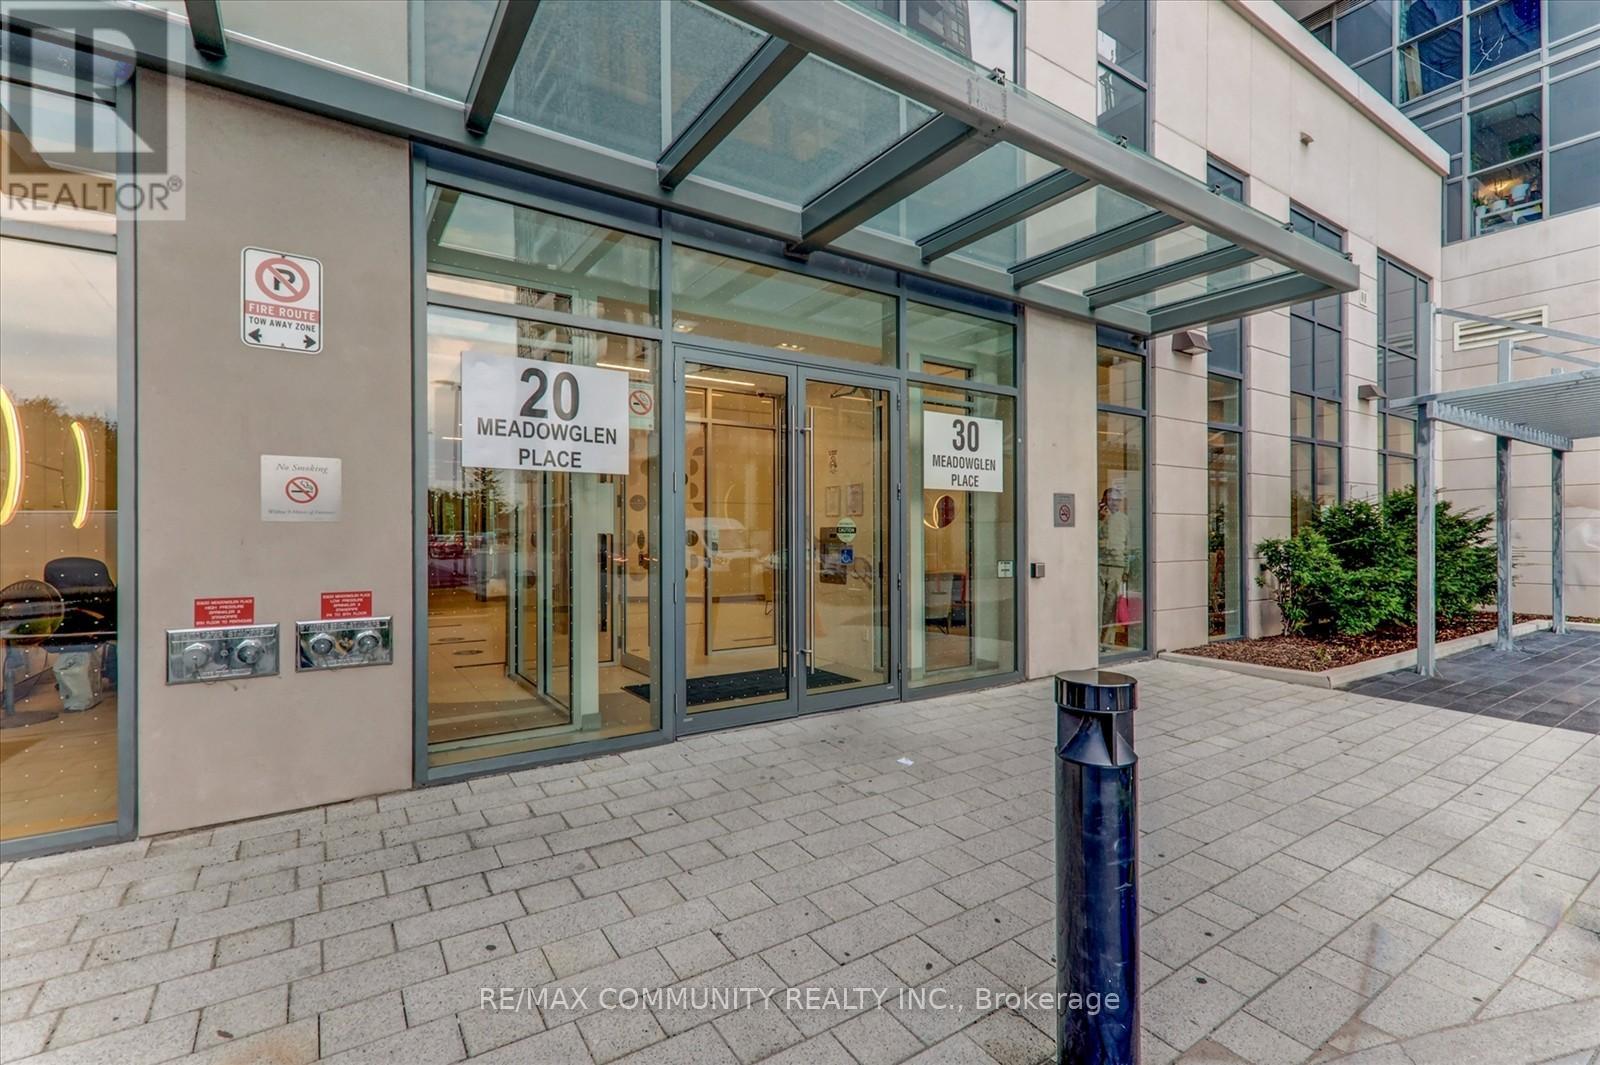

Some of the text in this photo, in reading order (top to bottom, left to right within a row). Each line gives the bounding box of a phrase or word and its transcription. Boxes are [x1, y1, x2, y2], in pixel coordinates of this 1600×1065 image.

[248, 303, 316, 320] FIRE ROUTE
[249, 316, 316, 332] TOW AWAY ZONE
[520, 367, 580, 421] 20
[478, 417, 617, 445] MEADOWGLEN
[952, 419, 980, 452] 30
[519, 448, 582, 468] PLACE
[932, 454, 996, 471] MEADOWGLEN
[292, 464, 328, 474] Smoking
[951, 474, 979, 488] PLACE
